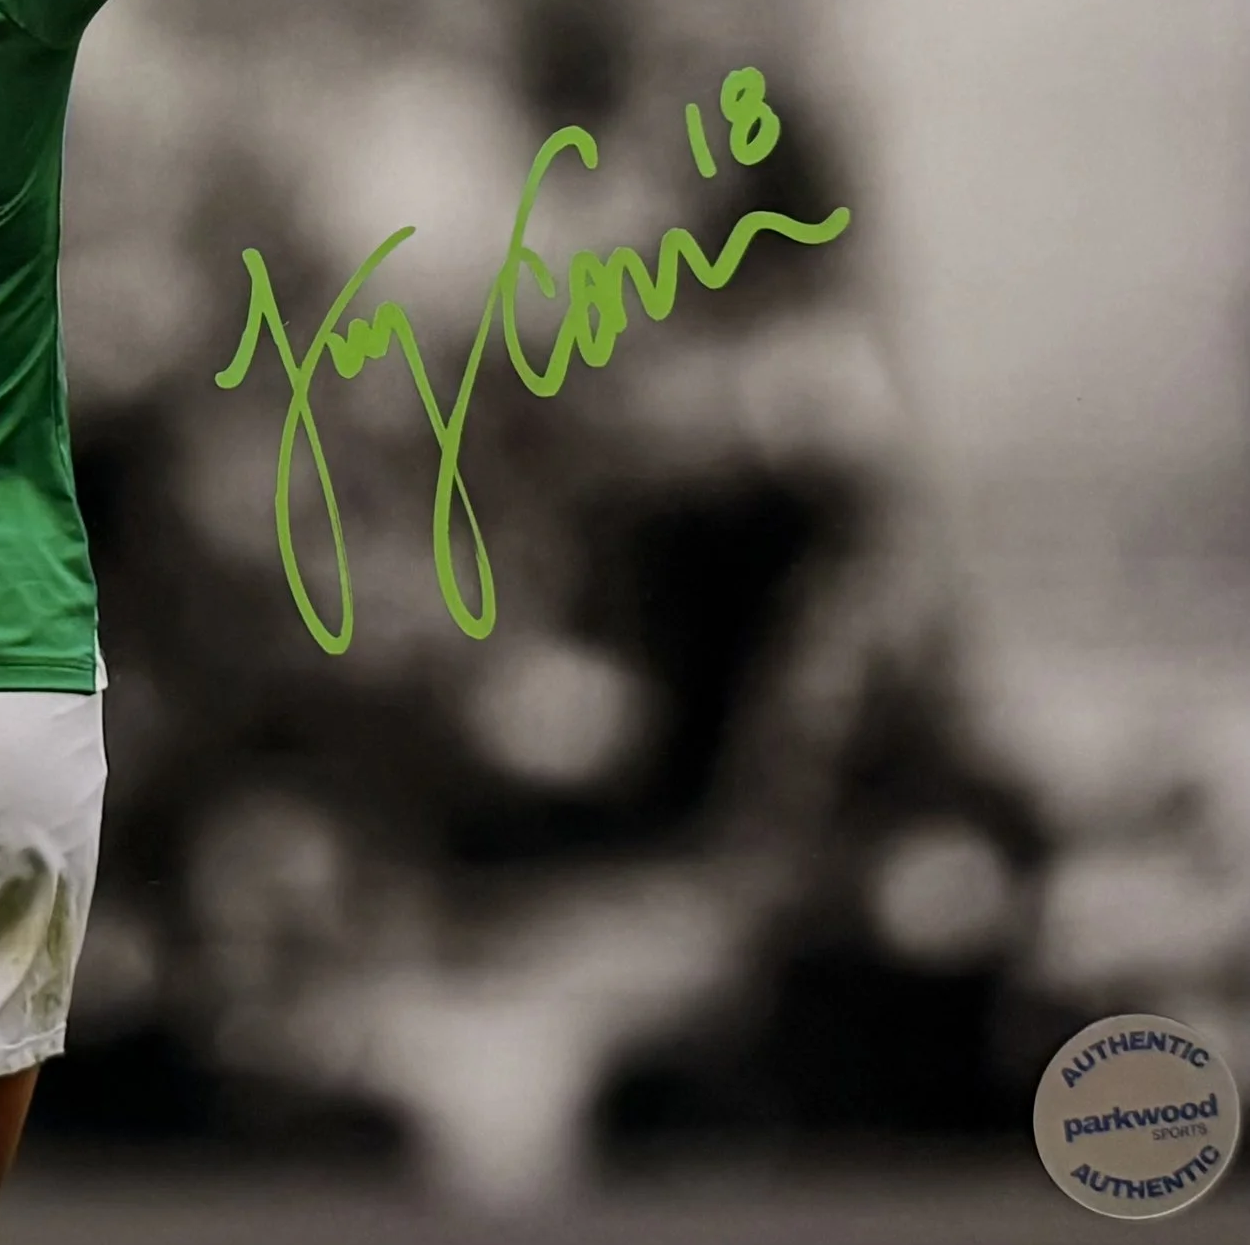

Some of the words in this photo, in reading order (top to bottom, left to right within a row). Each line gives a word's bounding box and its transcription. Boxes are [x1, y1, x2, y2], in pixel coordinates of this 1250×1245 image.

[686, 67, 781, 178] 18
[1061, 1030, 1210, 1088] AUTHENTIC
[1063, 1092, 1219, 1143] parkwood
[1152, 1121, 1208, 1141] SPORTS
[1070, 1144, 1221, 1199] AUTHENTIC
